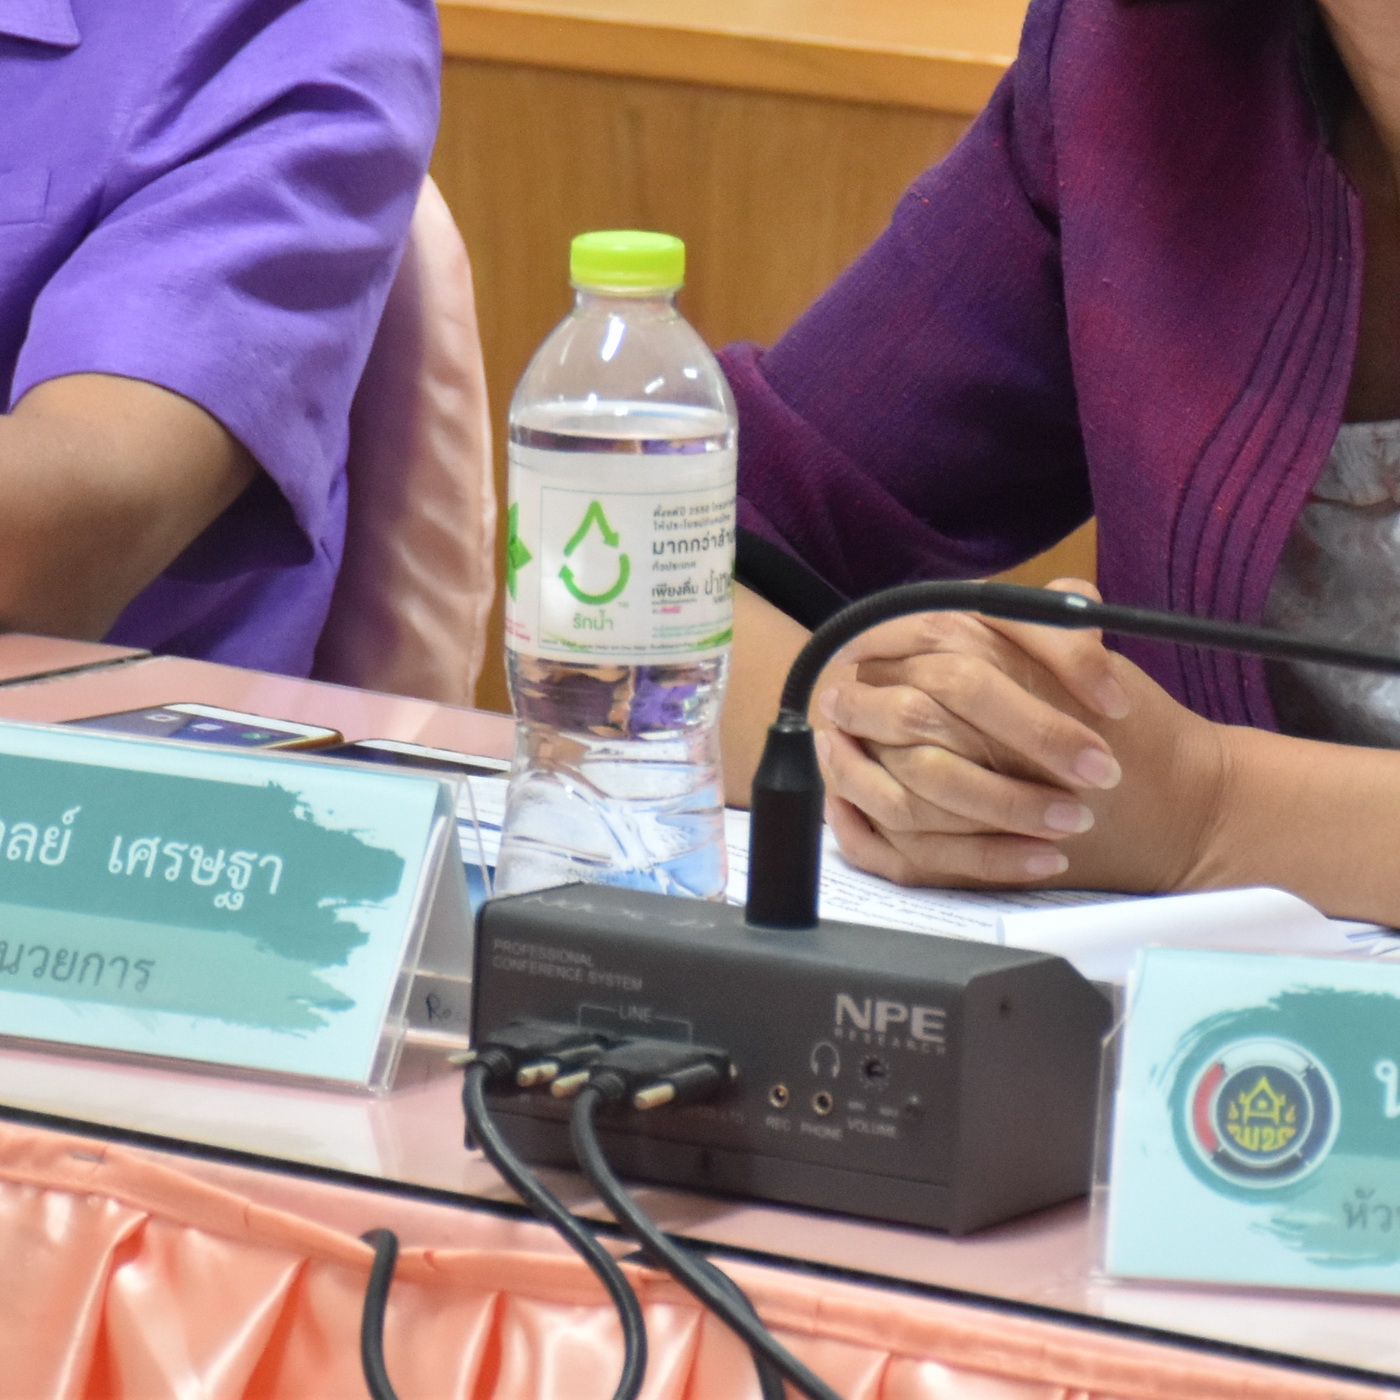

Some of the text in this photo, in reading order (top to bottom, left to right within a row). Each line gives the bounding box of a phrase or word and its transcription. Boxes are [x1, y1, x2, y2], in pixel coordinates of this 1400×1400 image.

[572, 609, 615, 632] รักน้ำ
[108, 837, 286, 911] เศรษฐา
[493, 938, 593, 966] PROFESSIONAL
[492, 955, 643, 992] CONFERENCE SYSTEM
[618, 1004, 652, 1023] LINE
[835, 992, 947, 1044] NPE
